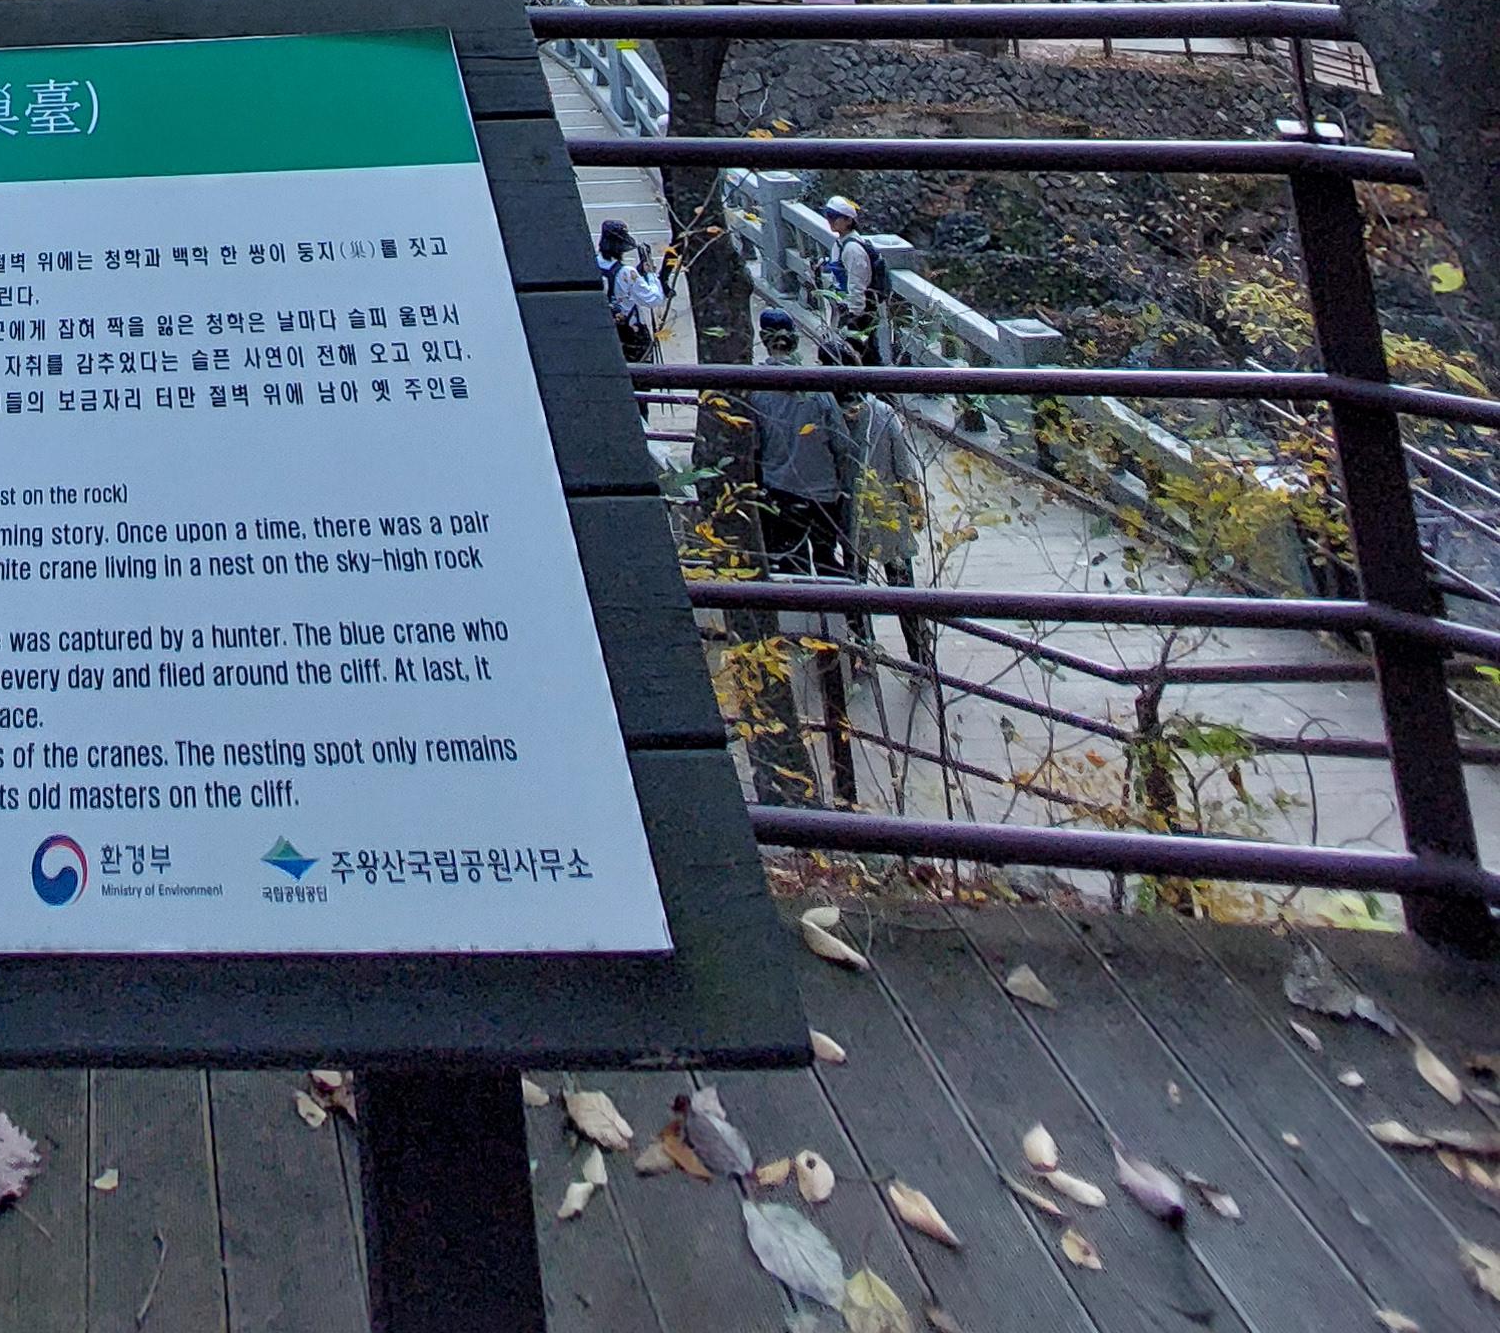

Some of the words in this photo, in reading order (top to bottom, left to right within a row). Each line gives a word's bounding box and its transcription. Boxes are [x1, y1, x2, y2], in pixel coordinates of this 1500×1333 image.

[36, 250, 94, 273] 위에는
[104, 247, 161, 271] 청학과
[172, 245, 209, 268] 백학
[219, 244, 238, 266] 한
[248, 242, 286, 265] 쌍이
[407, 236, 449, 258] 짓고
[58, 317, 95, 341] 잡혀
[106, 315, 145, 339] 짝을
[156, 314, 195, 338] 잃은
[205, 311, 266, 335] 청학은
[276, 308, 337, 333] 날마다
[347, 306, 388, 330] 슬피
[398, 302, 460, 328] 울면서
[4, 353, 64, 378] 자취를
[76, 350, 179, 376] 감추었다는
[191, 348, 231, 372] 슬픈
[243, 345, 305, 370] 사연이
[316, 343, 358, 367] 전해
[369, 341, 412, 366] 오고
[421, 338, 472, 364] 있다.
[58, 387, 142, 412] 보금자리
[155, 385, 196, 410] 터만
[208, 383, 250, 408] 절벽
[262, 381, 304, 406] 위에
[317, 379, 359, 405] 남아
[371, 378, 392, 403] 옛
[403, 376, 469, 402] 주인을
[22, 488, 44, 506] on
[48, 485, 78, 505] the
[83, 482, 128, 505] rock)
[51, 523, 110, 548] story.
[116, 520, 168, 545] Once
[175, 521, 228, 545] upon
[234, 521, 248, 541] a
[254, 517, 307, 541] time,
[312, 515, 372, 539] there
[378, 516, 423, 537] was
[429, 515, 443, 536] a
[449, 510, 490, 537] pair
[39, 559, 98, 581] crane
[104, 554, 157, 580] living
[163, 553, 182, 579] in
[189, 556, 202, 577] a
[208, 553, 256, 577] nest
[261, 554, 289, 576] on
[294, 550, 330, 575] the
[335, 546, 429, 575] sky-high
[433, 544, 484, 571] rock
[9, 631, 51, 653] was
[58, 625, 153, 654] captured
[159, 625, 184, 654] by
[191, 628, 205, 650] a
[211, 623, 288, 650] hunter.
[291, 622, 332, 649] The
[338, 620, 386, 646] blue
[392, 621, 456, 646] crane
[461, 616, 509, 643] who
[0, 668, 61, 693] every
[67, 663, 105, 692] day
[112, 662, 151, 689] and
[157, 661, 205, 689] flied
[211, 659, 289, 687] around
[295, 658, 333, 686] the
[339, 657, 388, 685] cliff.
[394, 656, 418, 684] At
[421, 656, 470, 683] last,
[473, 654, 493, 681] it
[12, 742, 36, 770] of
[42, 741, 79, 770] the
[87, 744, 169, 770] cranes.
[174, 739, 215, 769] The
[223, 738, 306, 769] nesting
[313, 738, 366, 767] spot
[371, 735, 417, 766] only
[424, 734, 518, 763] remains
[27, 781, 61, 811] old
[68, 782, 161, 811] masters
[168, 785, 197, 809] on
[203, 780, 242, 809] the
[250, 777, 300, 809] cliff.
[99, 843, 172, 877] 환경부
[330, 847, 594, 886] 주왕산국립공원사무소
[101, 883, 143, 899] Ministry
[144, 883, 155, 897] of
[158, 883, 224, 897] Environment
[261, 885, 328, 904] 국립공원공단
